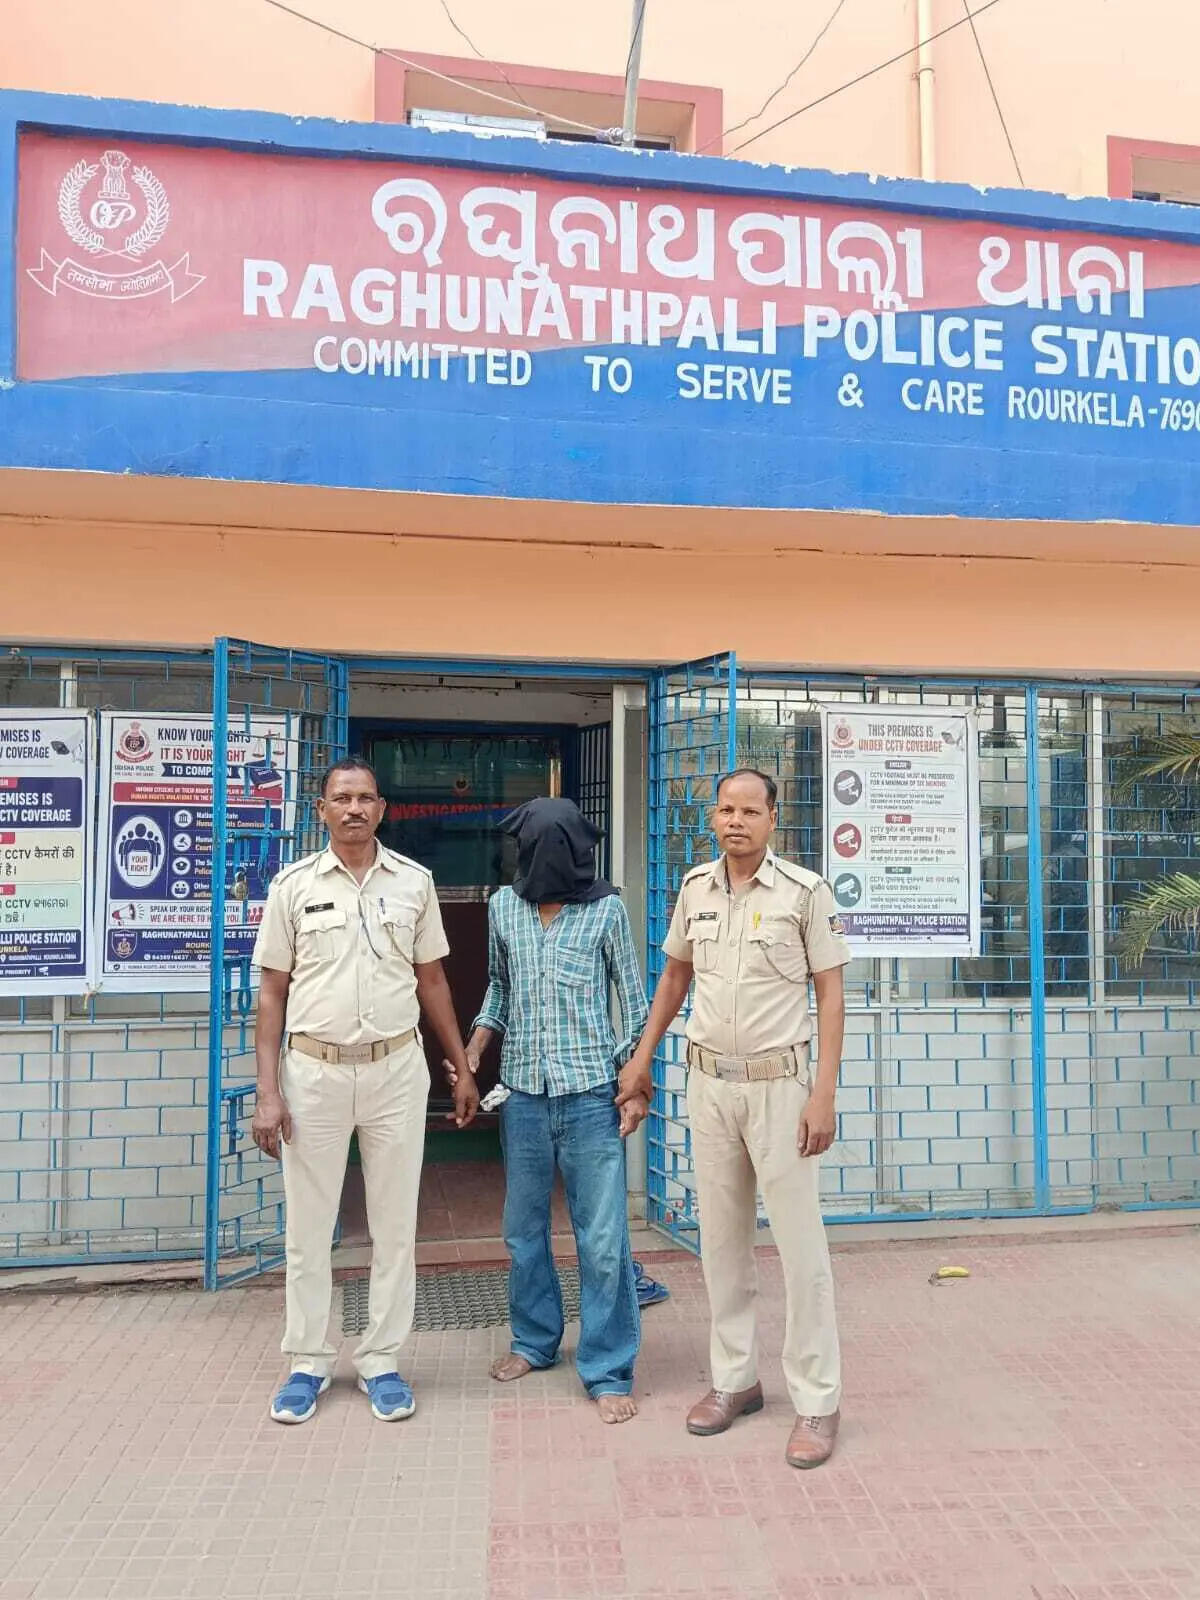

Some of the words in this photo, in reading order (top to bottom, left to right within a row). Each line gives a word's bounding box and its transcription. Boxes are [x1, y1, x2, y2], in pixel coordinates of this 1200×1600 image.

[977, 236, 1144, 319] ଥାନା
[243, 258, 778, 355] RAGHUNATHPALI
[803, 305, 1004, 371] POLICE
[313, 336, 533, 387] COMMITTED
[584, 356, 633, 394] TO
[676, 362, 792, 404] SERVE
[838, 373, 864, 409] &
[902, 377, 985, 416] CARE
[32, 729, 41, 743] IS
[157, 727, 187, 742] KNOW
[868, 724, 885, 736] THIS
[887, 725, 924, 737] PREMISES
[926, 726, 934, 737] IS
[6, 746, 49, 759] COVERAGE
[858, 740, 882, 752] UNDER
[885, 740, 904, 752] CCTV
[906, 741, 943, 753] COVERAGE
[160, 747, 170, 761] IT
[173, 748, 183, 761] IS
[171, 765, 183, 776] TO
[42, 792, 53, 806] IS
[21, 809, 72, 822] COVERAGE
[5, 849, 31, 860] CCTV
[62, 845, 75, 859] की
[5, 899, 31, 910] CCTV
[163, 914, 177, 922] ARE
[853, 915, 912, 926] RAGHUNATHPALLI
[914, 916, 938, 926] POLICE
[940, 916, 967, 926] STATION
[14, 932, 43, 945] POLICE
[44, 931, 77, 944] STATION
[142, 931, 209, 939] RAGHUNATHPALLI
